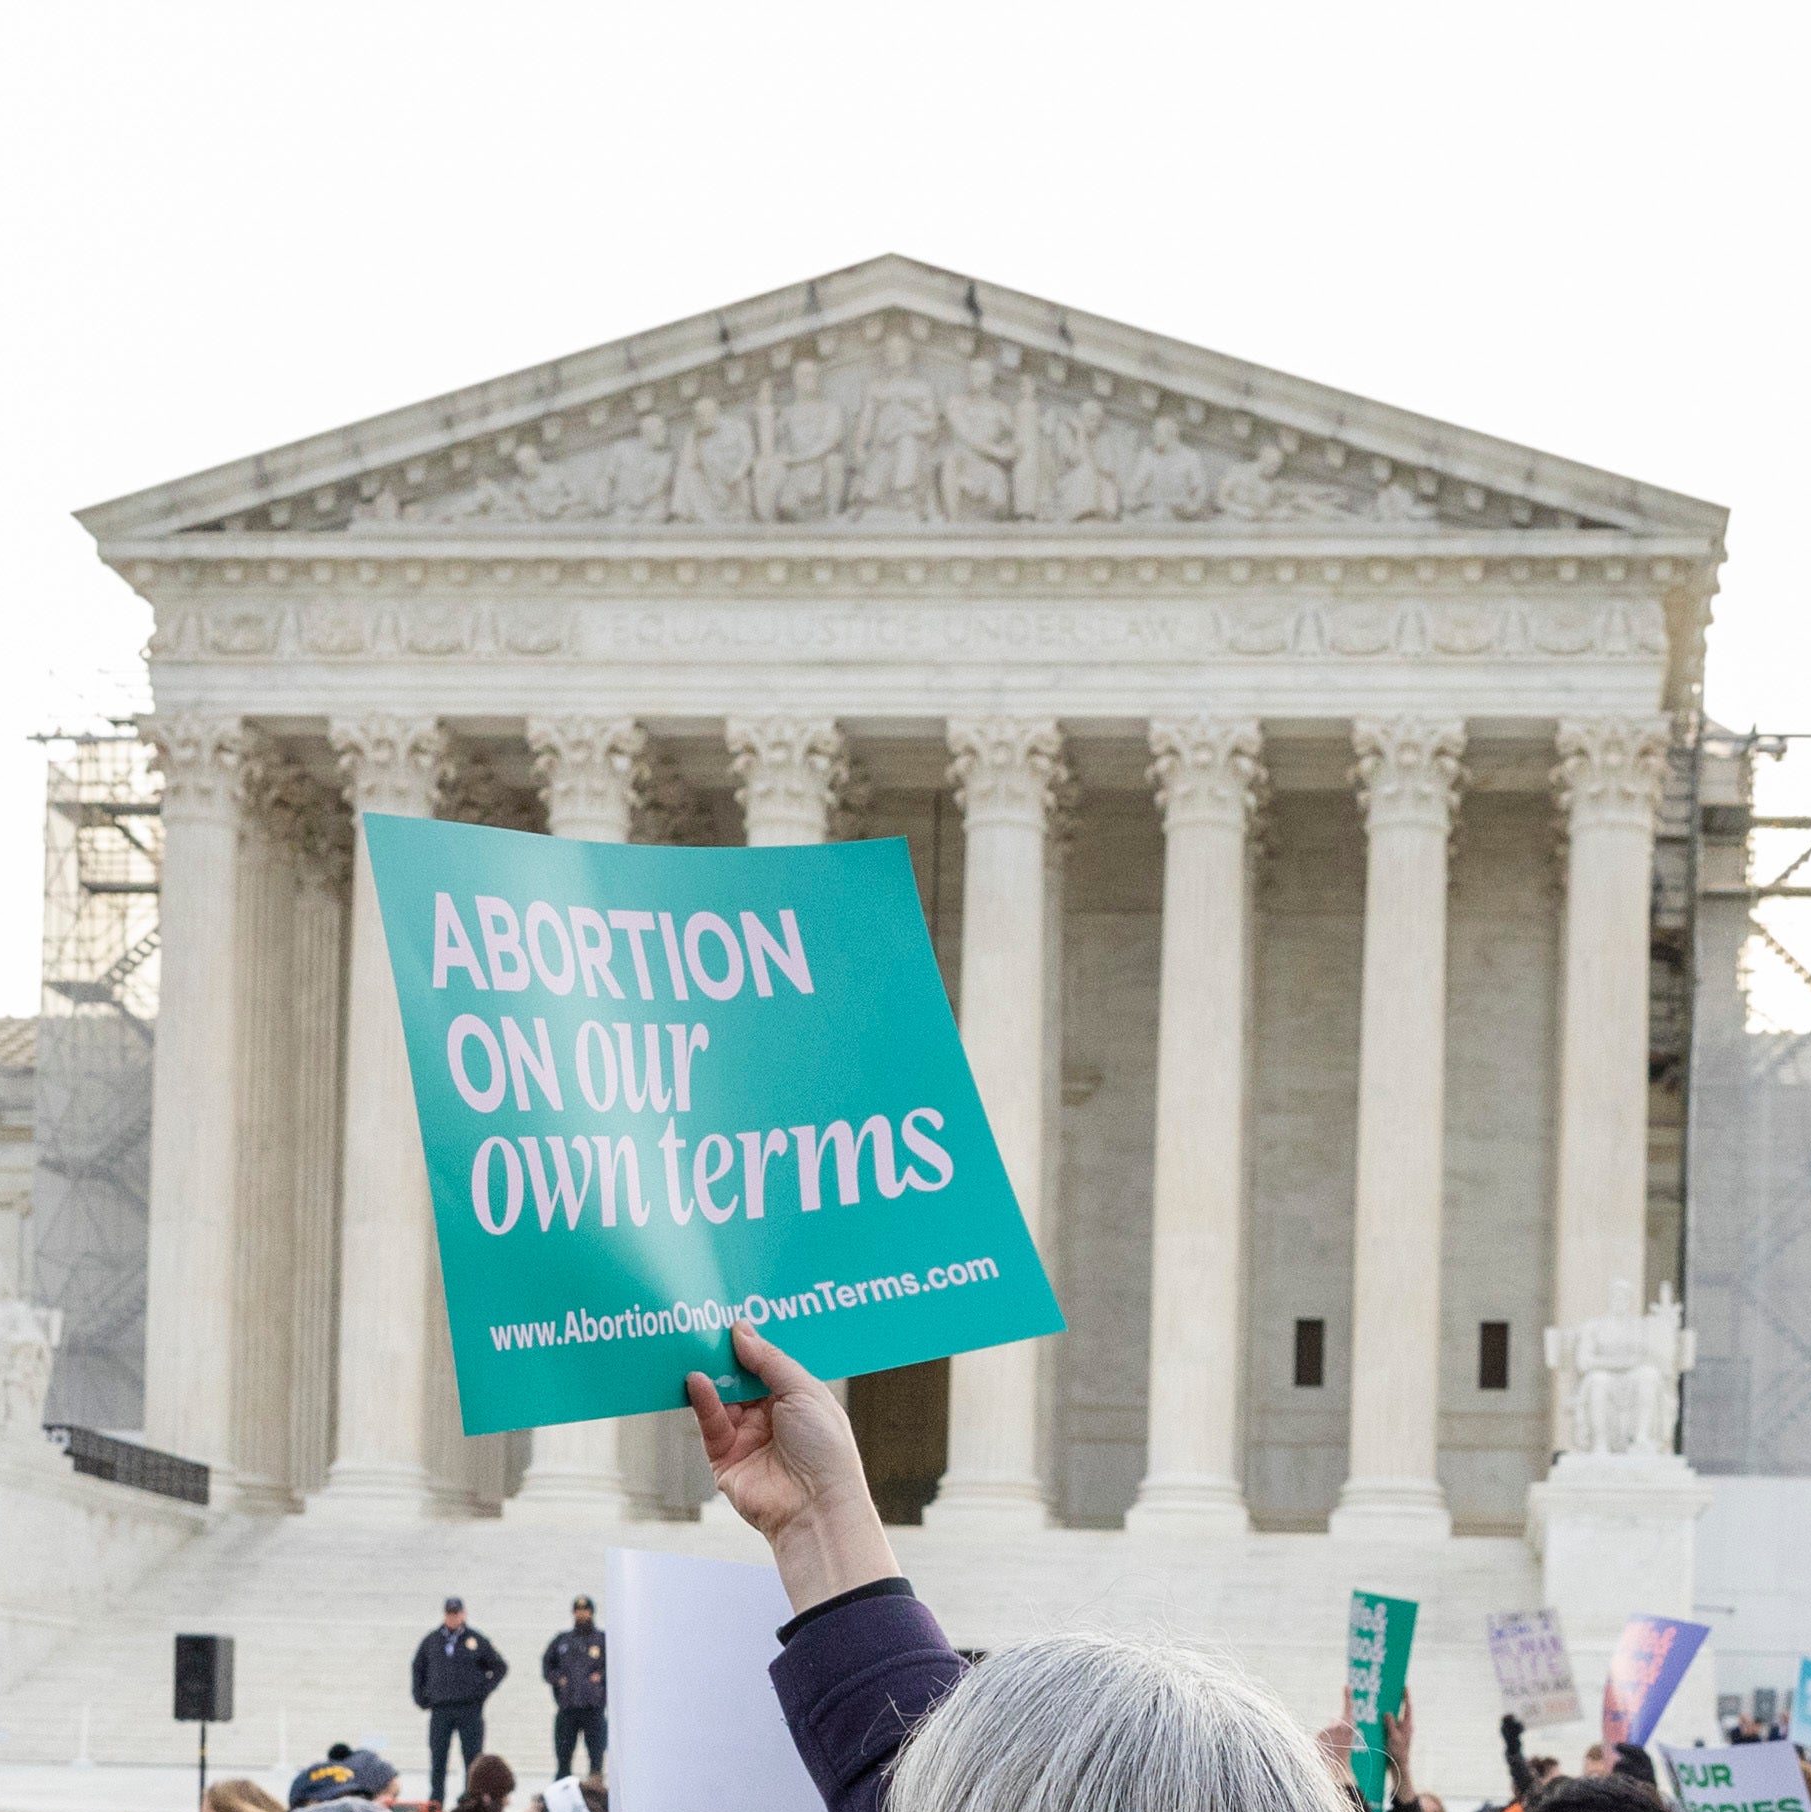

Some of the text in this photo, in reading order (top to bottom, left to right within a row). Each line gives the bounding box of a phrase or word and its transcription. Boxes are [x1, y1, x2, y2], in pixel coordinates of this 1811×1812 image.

[432, 892, 815, 1000] ABORTION
[447, 1014, 710, 1113] ON our
[472, 1106, 955, 1235] own terms
[489, 1252, 1001, 1352] www.AbortionOnOurOwnTerms.com
[1676, 1762, 1733, 1788] OUR
